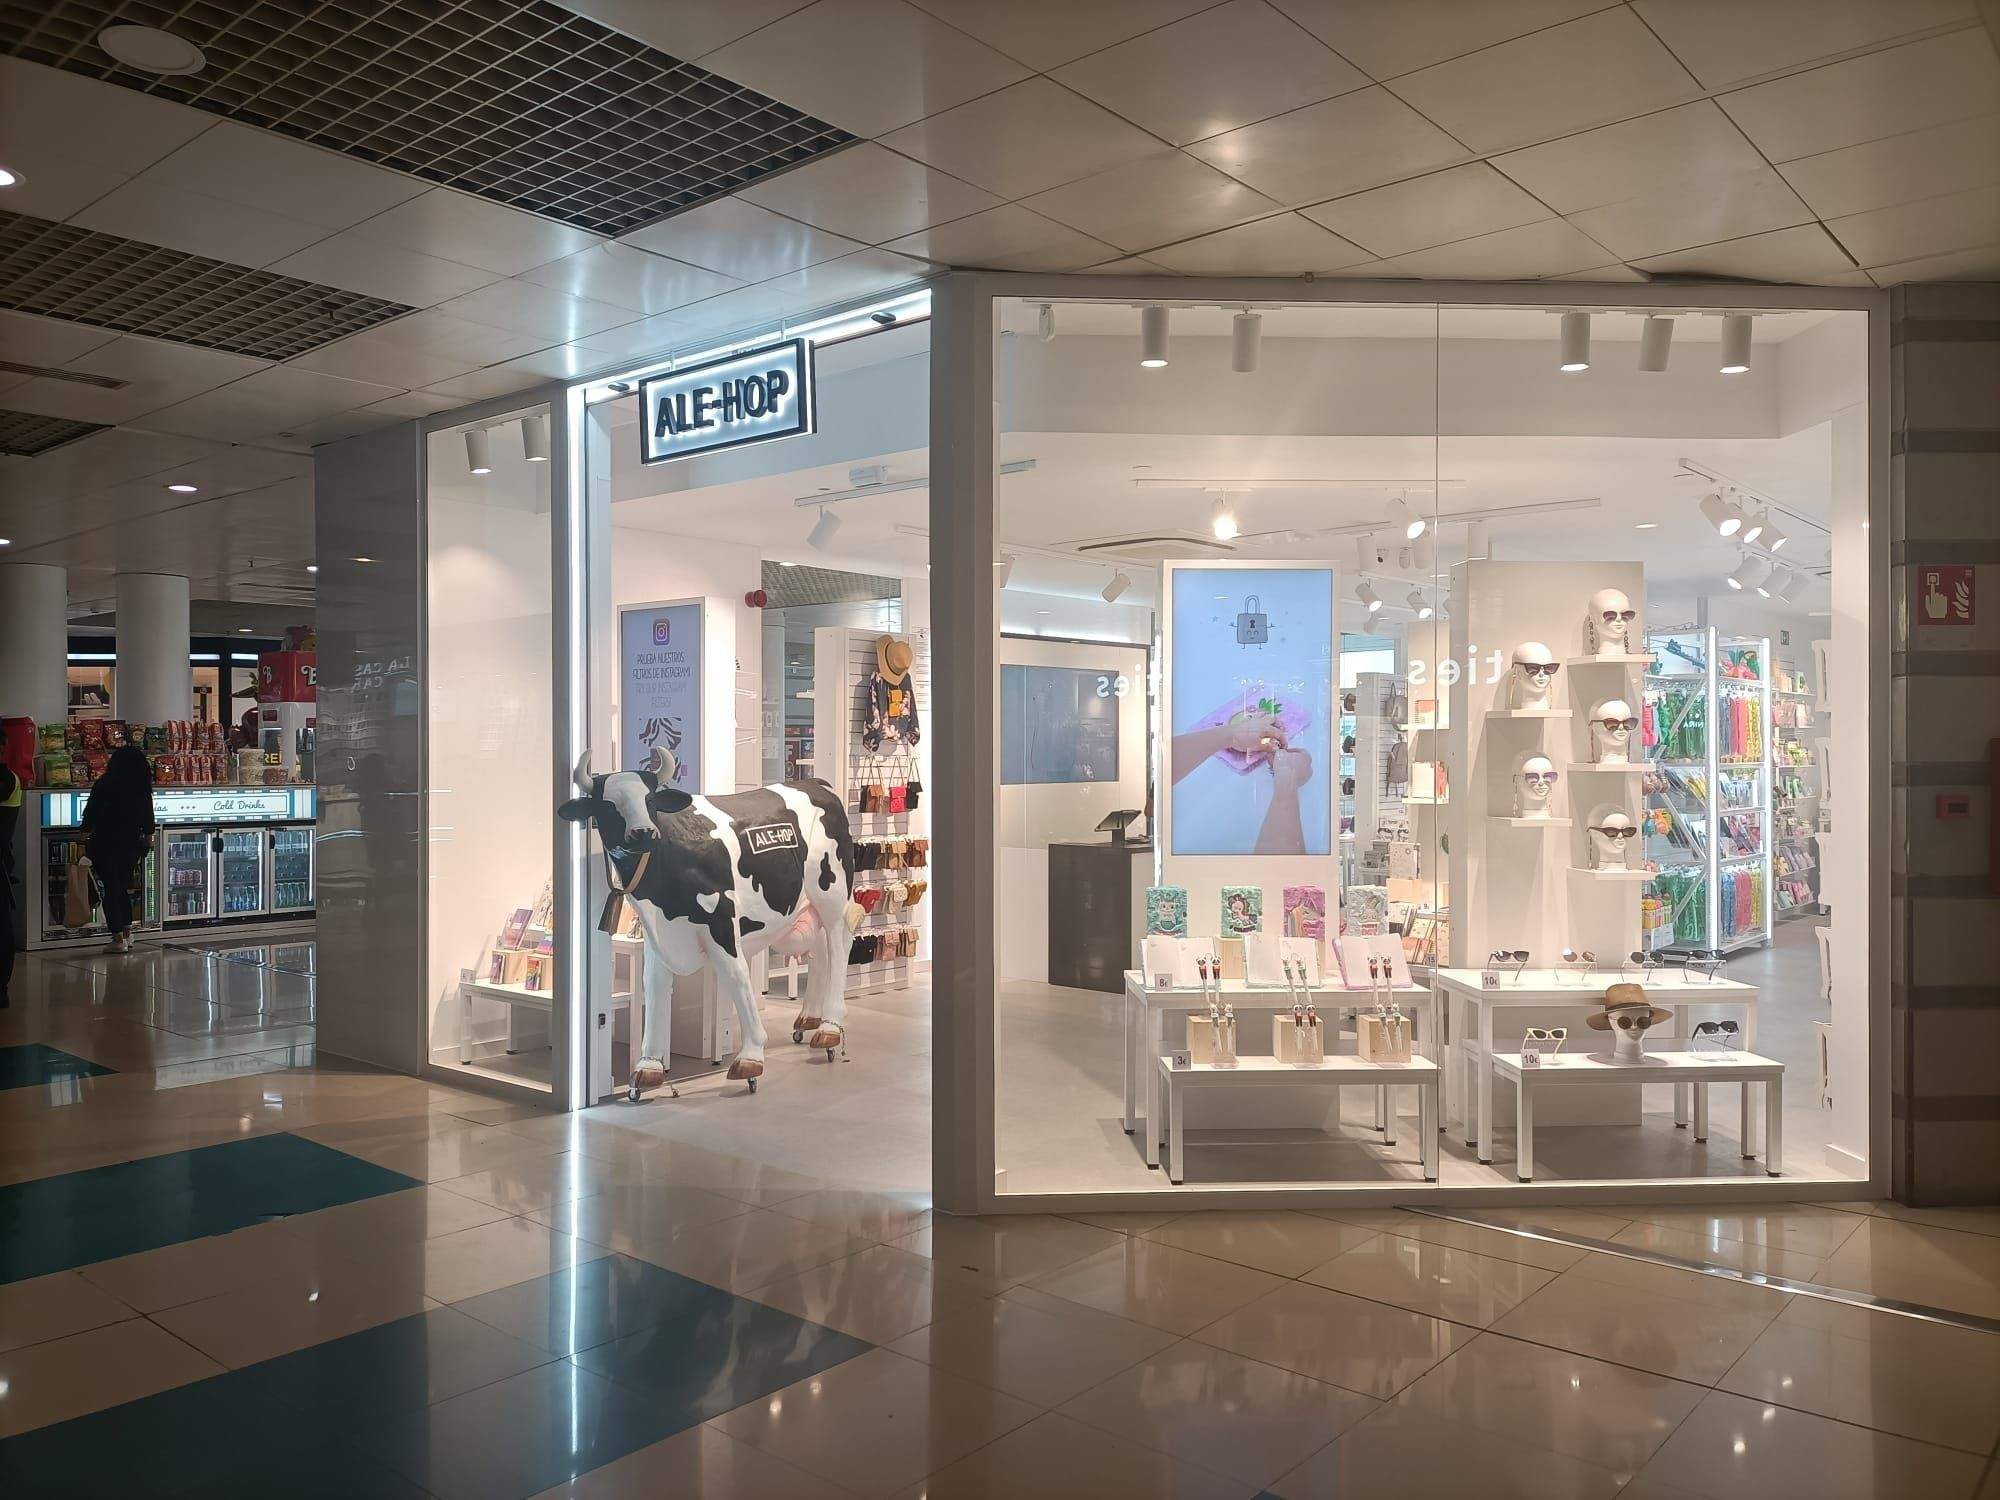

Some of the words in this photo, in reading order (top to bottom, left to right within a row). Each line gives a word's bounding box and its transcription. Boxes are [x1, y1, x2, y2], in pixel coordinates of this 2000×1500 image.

[654, 369, 789, 438] ALE-HOP
[213, 799, 234, 811] Cold
[237, 799, 266, 810] Drinks
[755, 828, 794, 848] ALE-HOP
[1176, 1055, 1187, 1066] 3€
